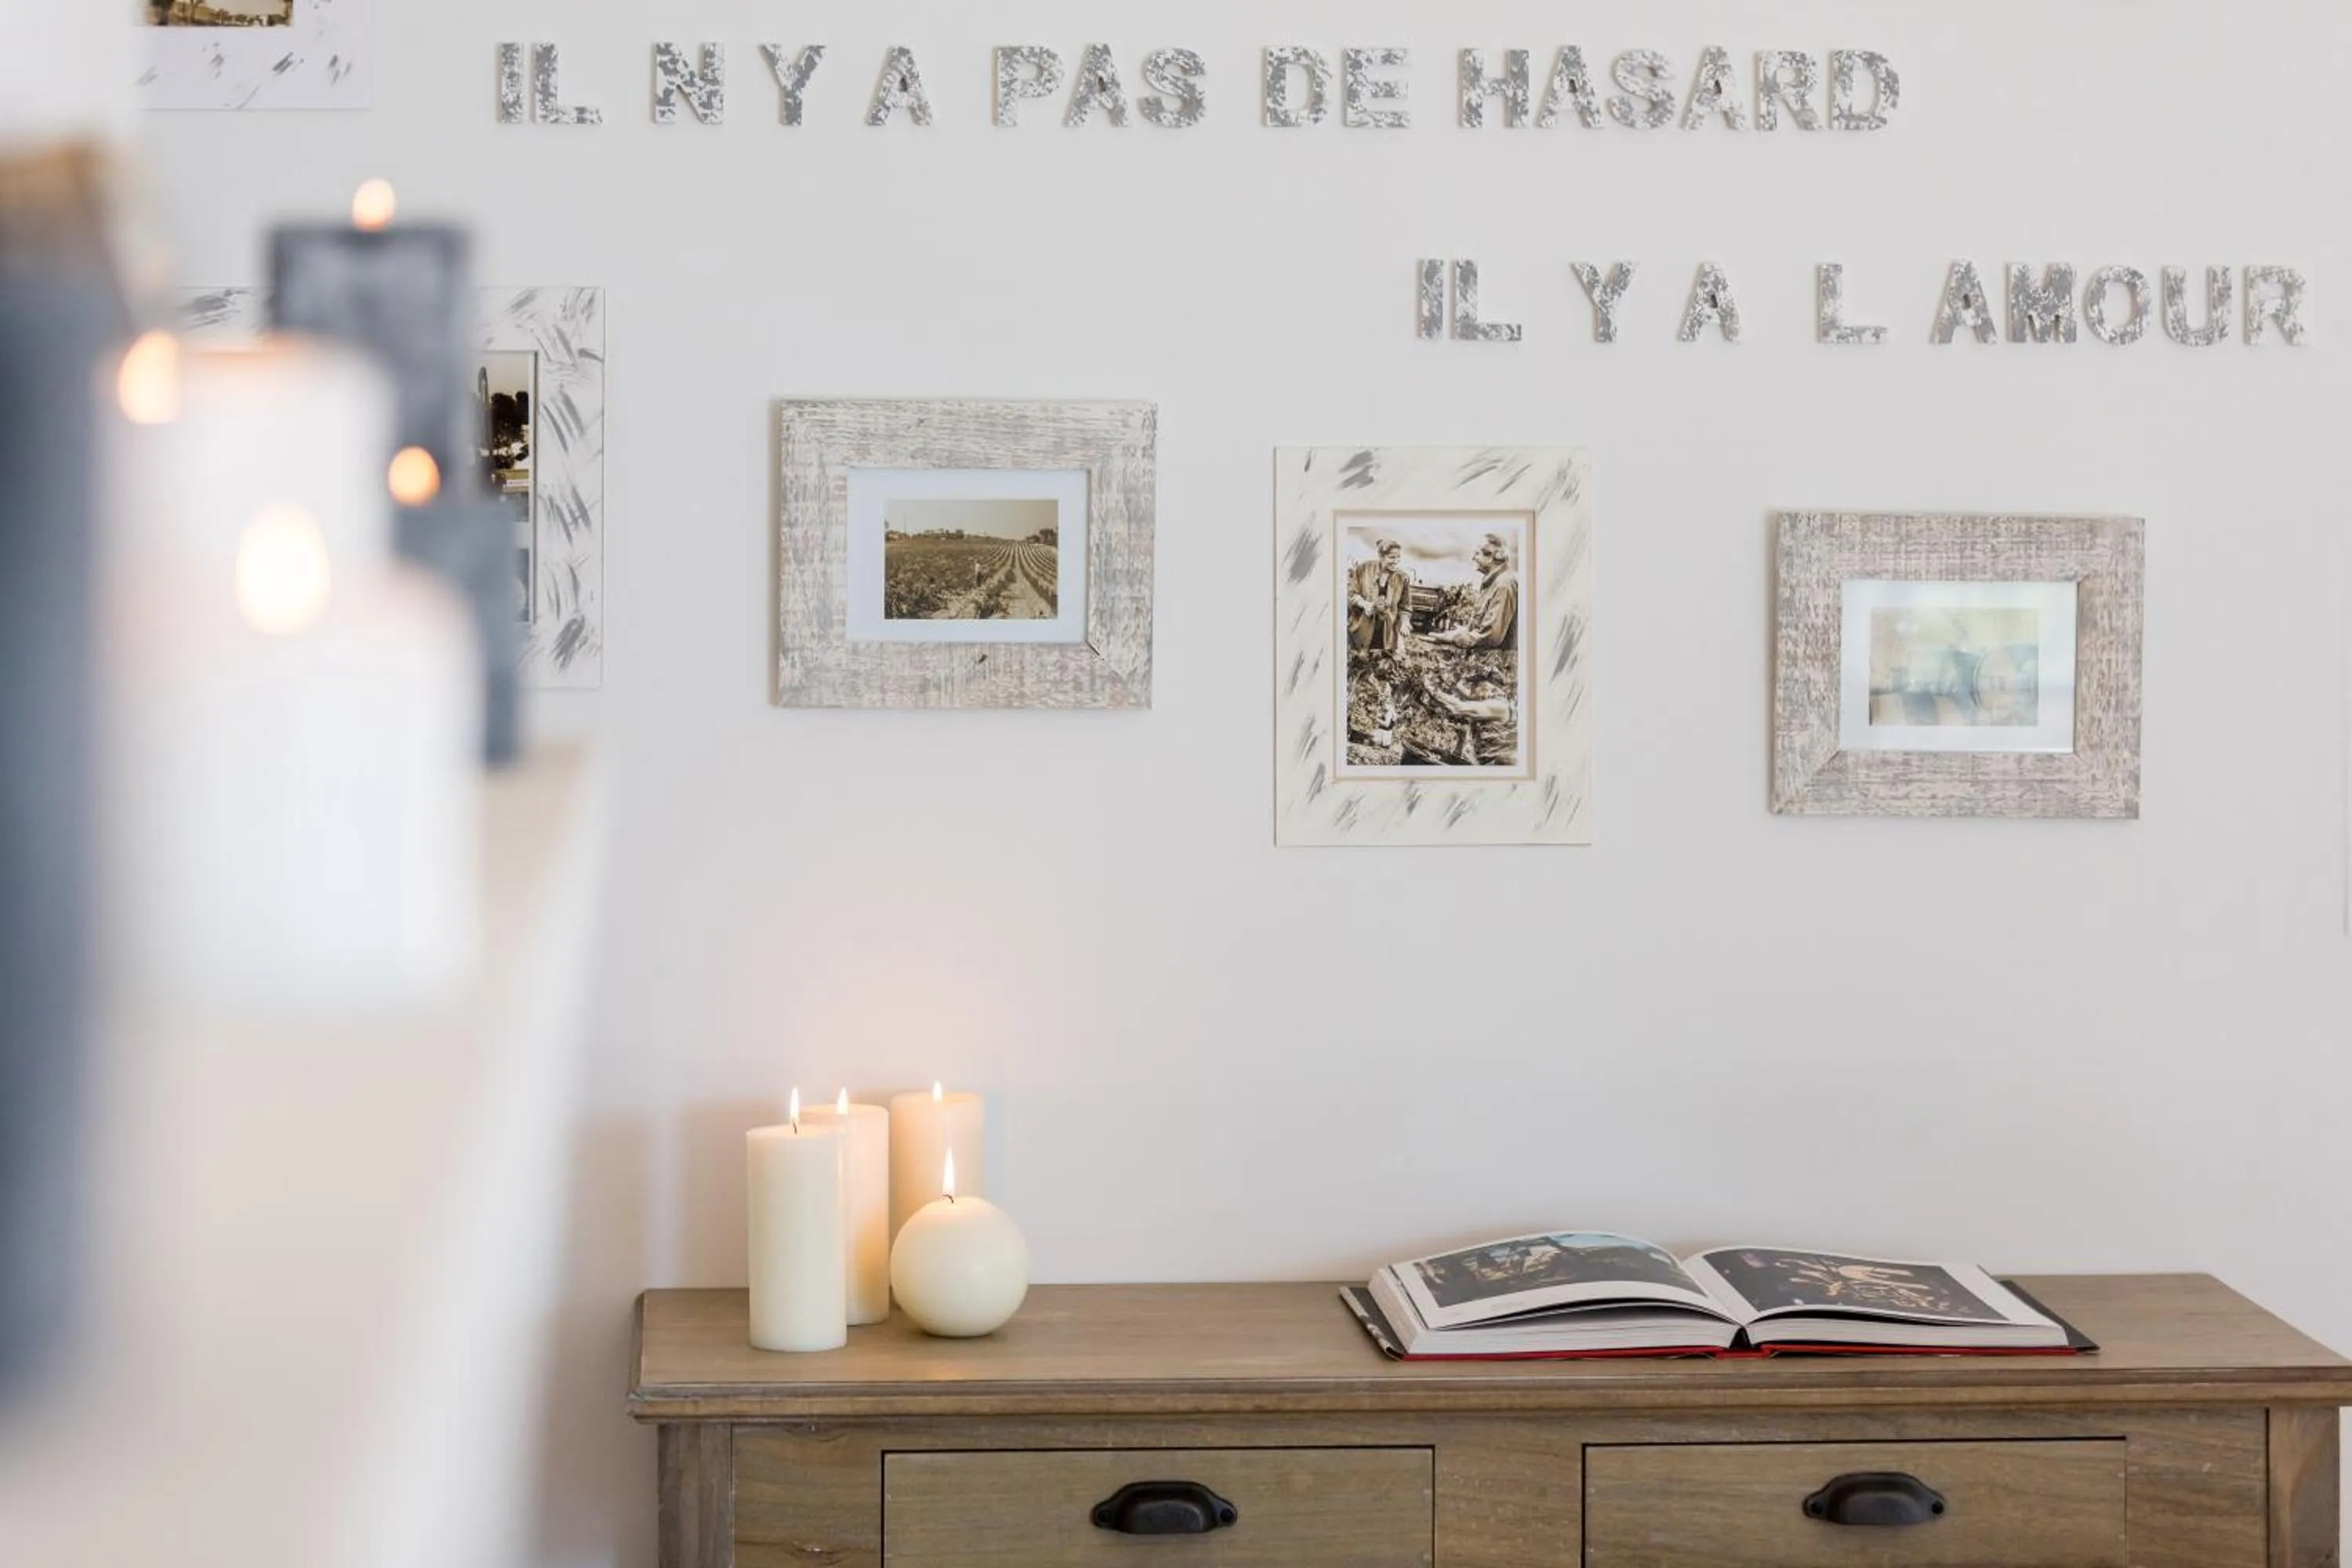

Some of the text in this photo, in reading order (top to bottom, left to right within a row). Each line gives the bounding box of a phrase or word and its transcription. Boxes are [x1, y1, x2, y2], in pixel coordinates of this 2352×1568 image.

[496, 42, 1900, 132] IL N Y A PAS DE HASARD
[1416, 258, 2308, 347] IL Y A L AMOUR
